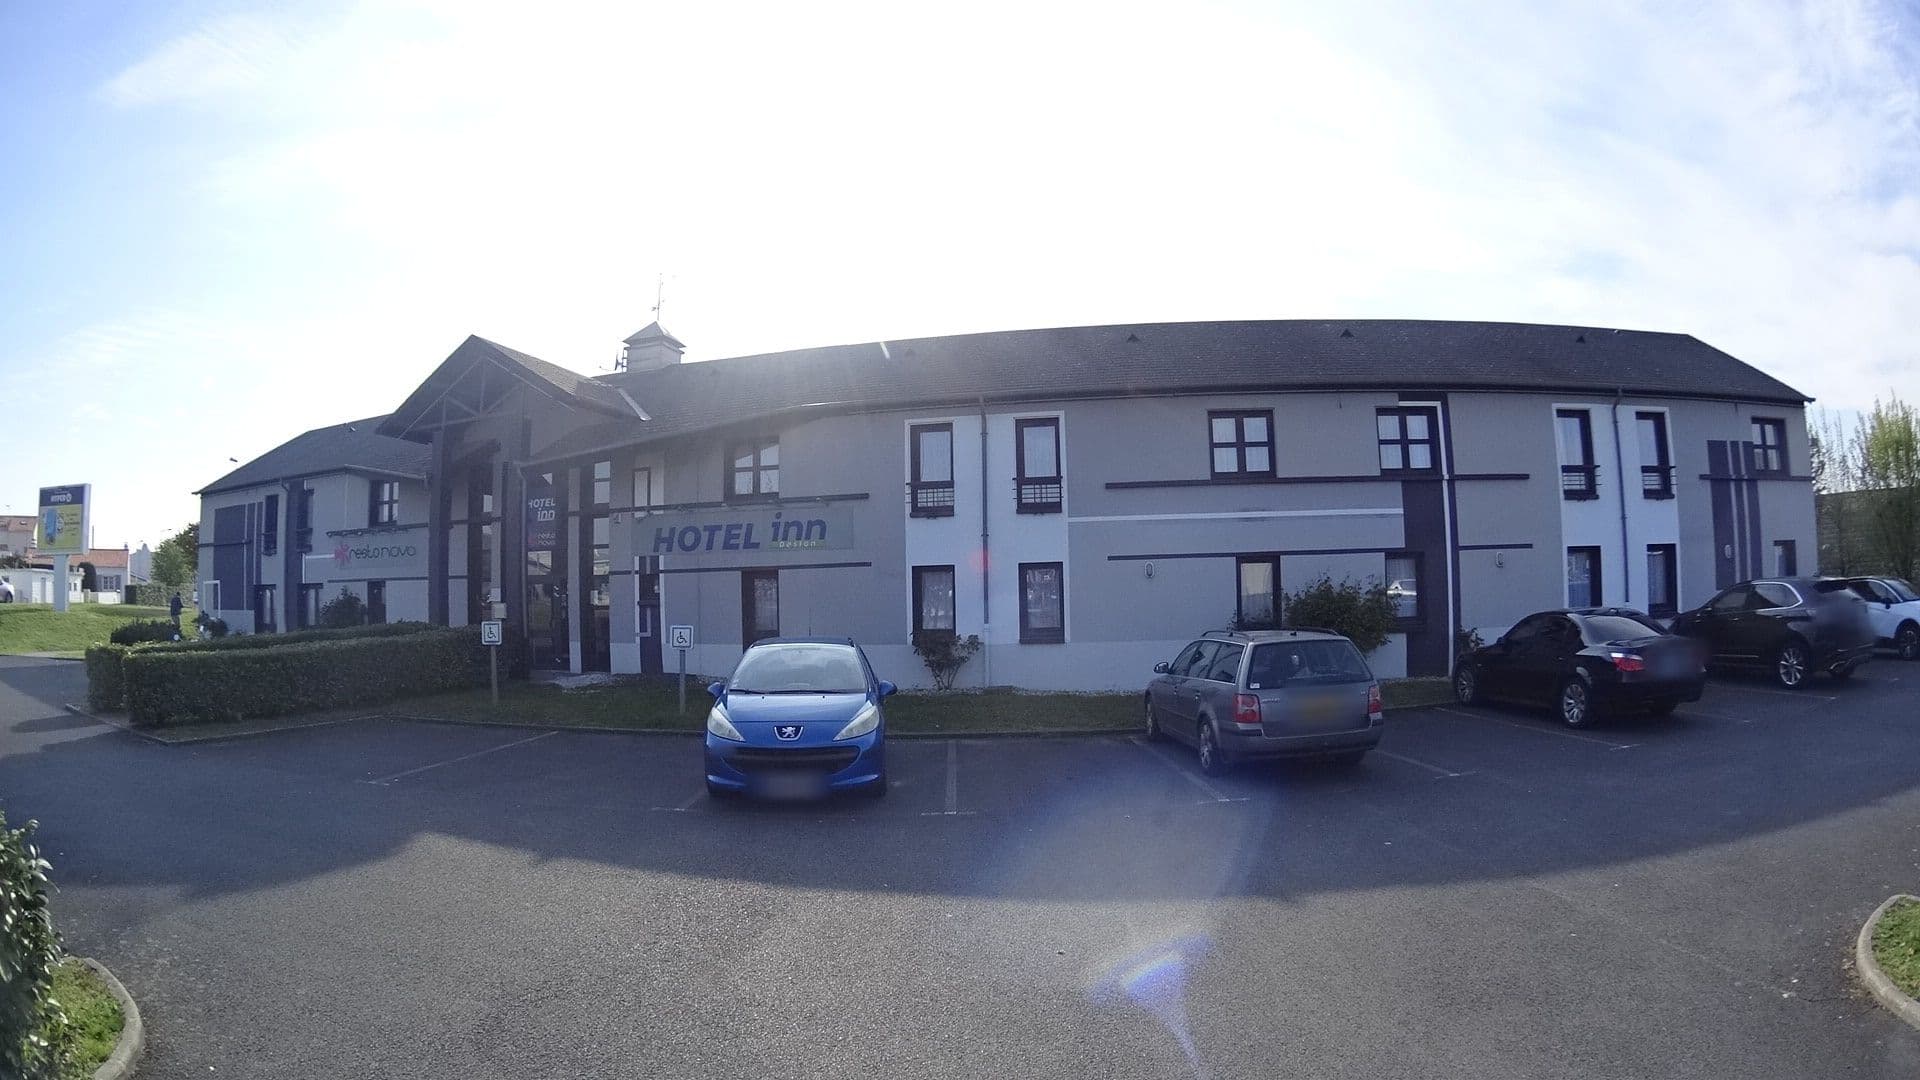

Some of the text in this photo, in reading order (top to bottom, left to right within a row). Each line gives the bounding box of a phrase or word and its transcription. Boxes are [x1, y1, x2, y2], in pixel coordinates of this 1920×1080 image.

[528, 498, 556, 508] HOTEL
[537, 507, 556, 521] inn
[653, 511, 827, 553] HOTEL inn
